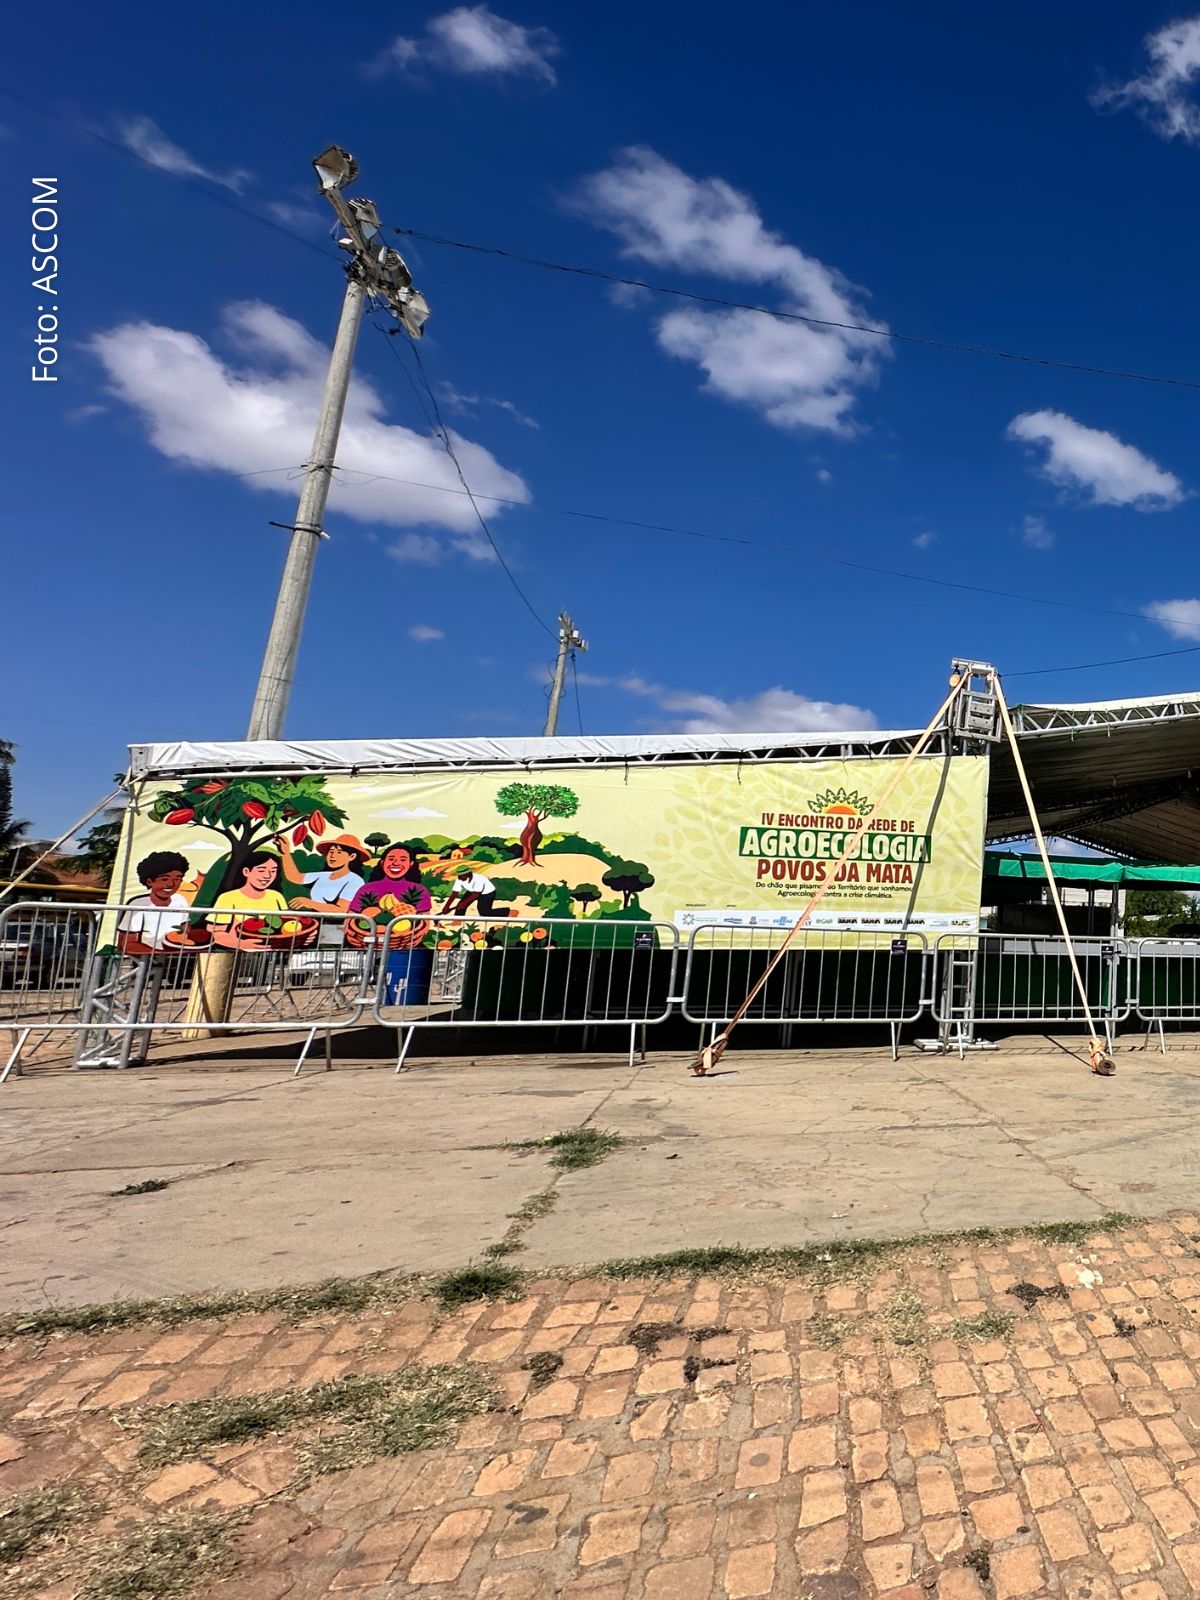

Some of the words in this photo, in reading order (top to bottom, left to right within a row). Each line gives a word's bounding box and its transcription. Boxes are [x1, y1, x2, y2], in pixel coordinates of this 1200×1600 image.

[761, 813, 774, 825] IV
[778, 814, 844, 829] ENCONTRO
[900, 820, 915, 832] DE
[741, 828, 929, 862] AGROECOLOGIA
[757, 859, 827, 881] POVOS
[834, 862, 860, 882] DA
[866, 863, 913, 884] MATA
[767, 881, 784, 889] chão
[838, 883, 866, 891] Território
